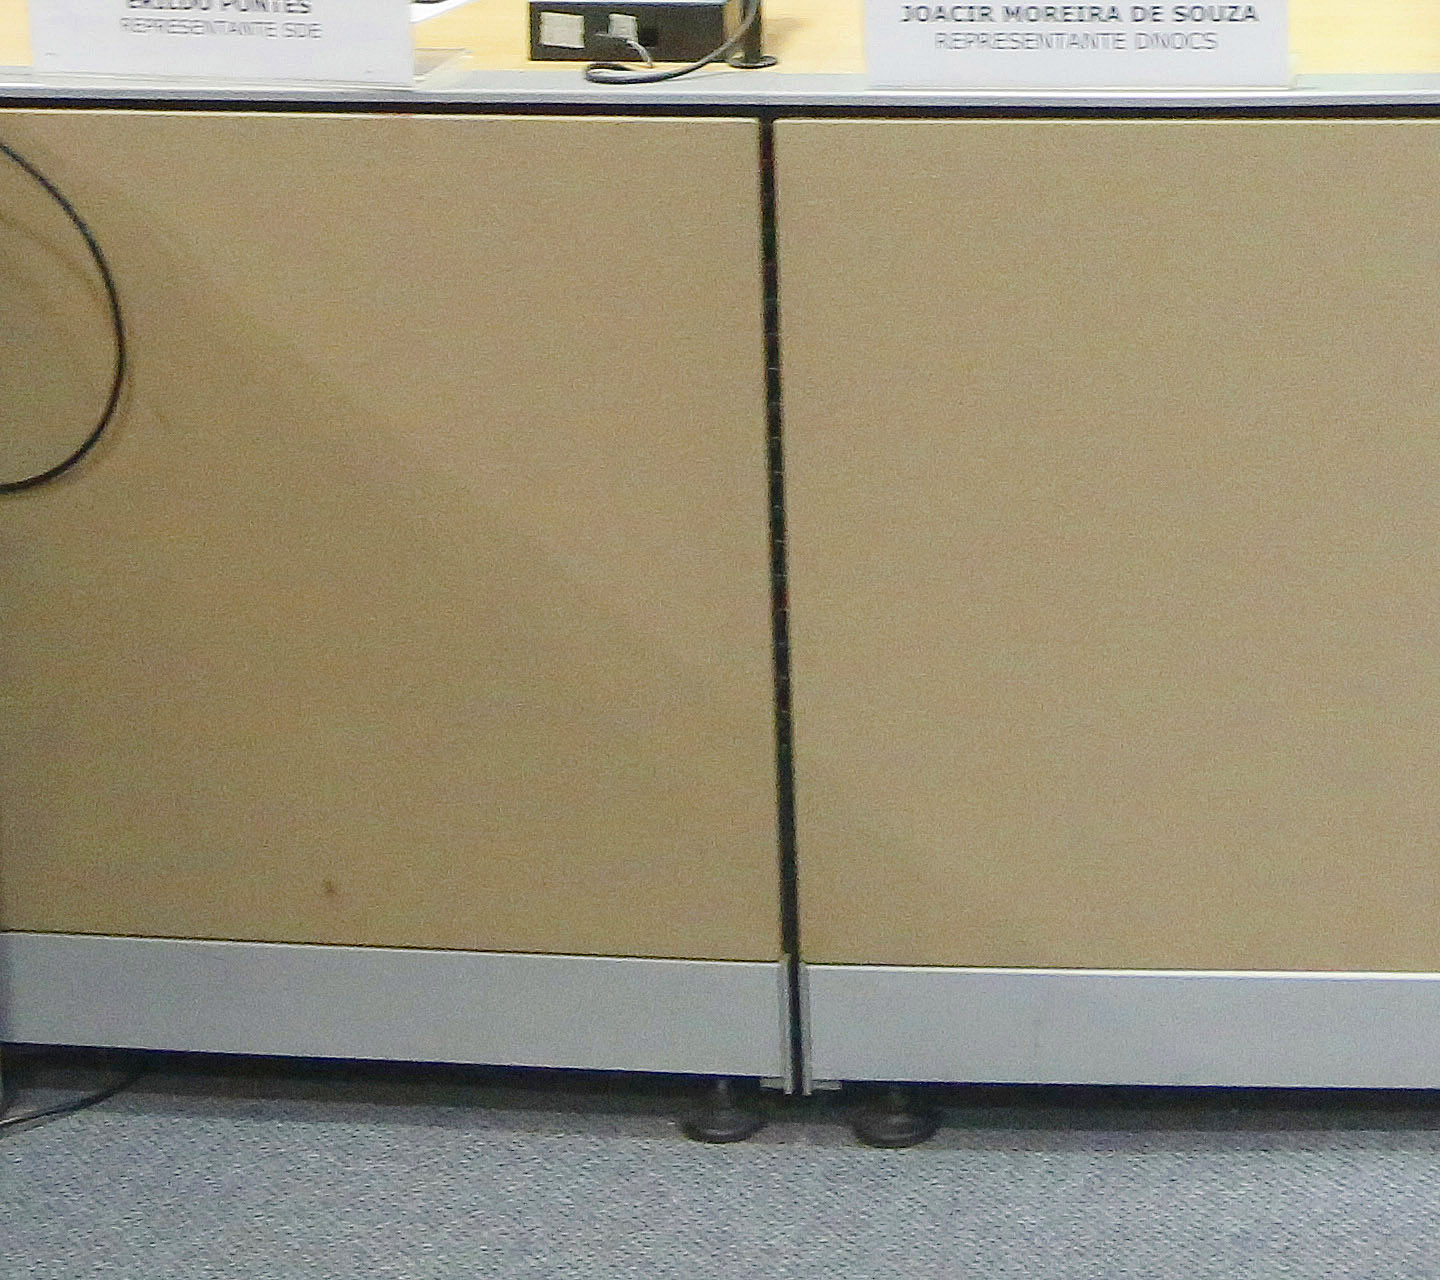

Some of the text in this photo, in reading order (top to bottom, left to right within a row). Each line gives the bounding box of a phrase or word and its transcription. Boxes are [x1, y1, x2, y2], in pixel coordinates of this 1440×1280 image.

[900, 5, 1260, 23] JOACIR MOREIRA DE SOUZA
[119, 17, 279, 39] REPRESENTANTE
[935, 31, 1218, 51] REPRESENTANTE DNOCS
